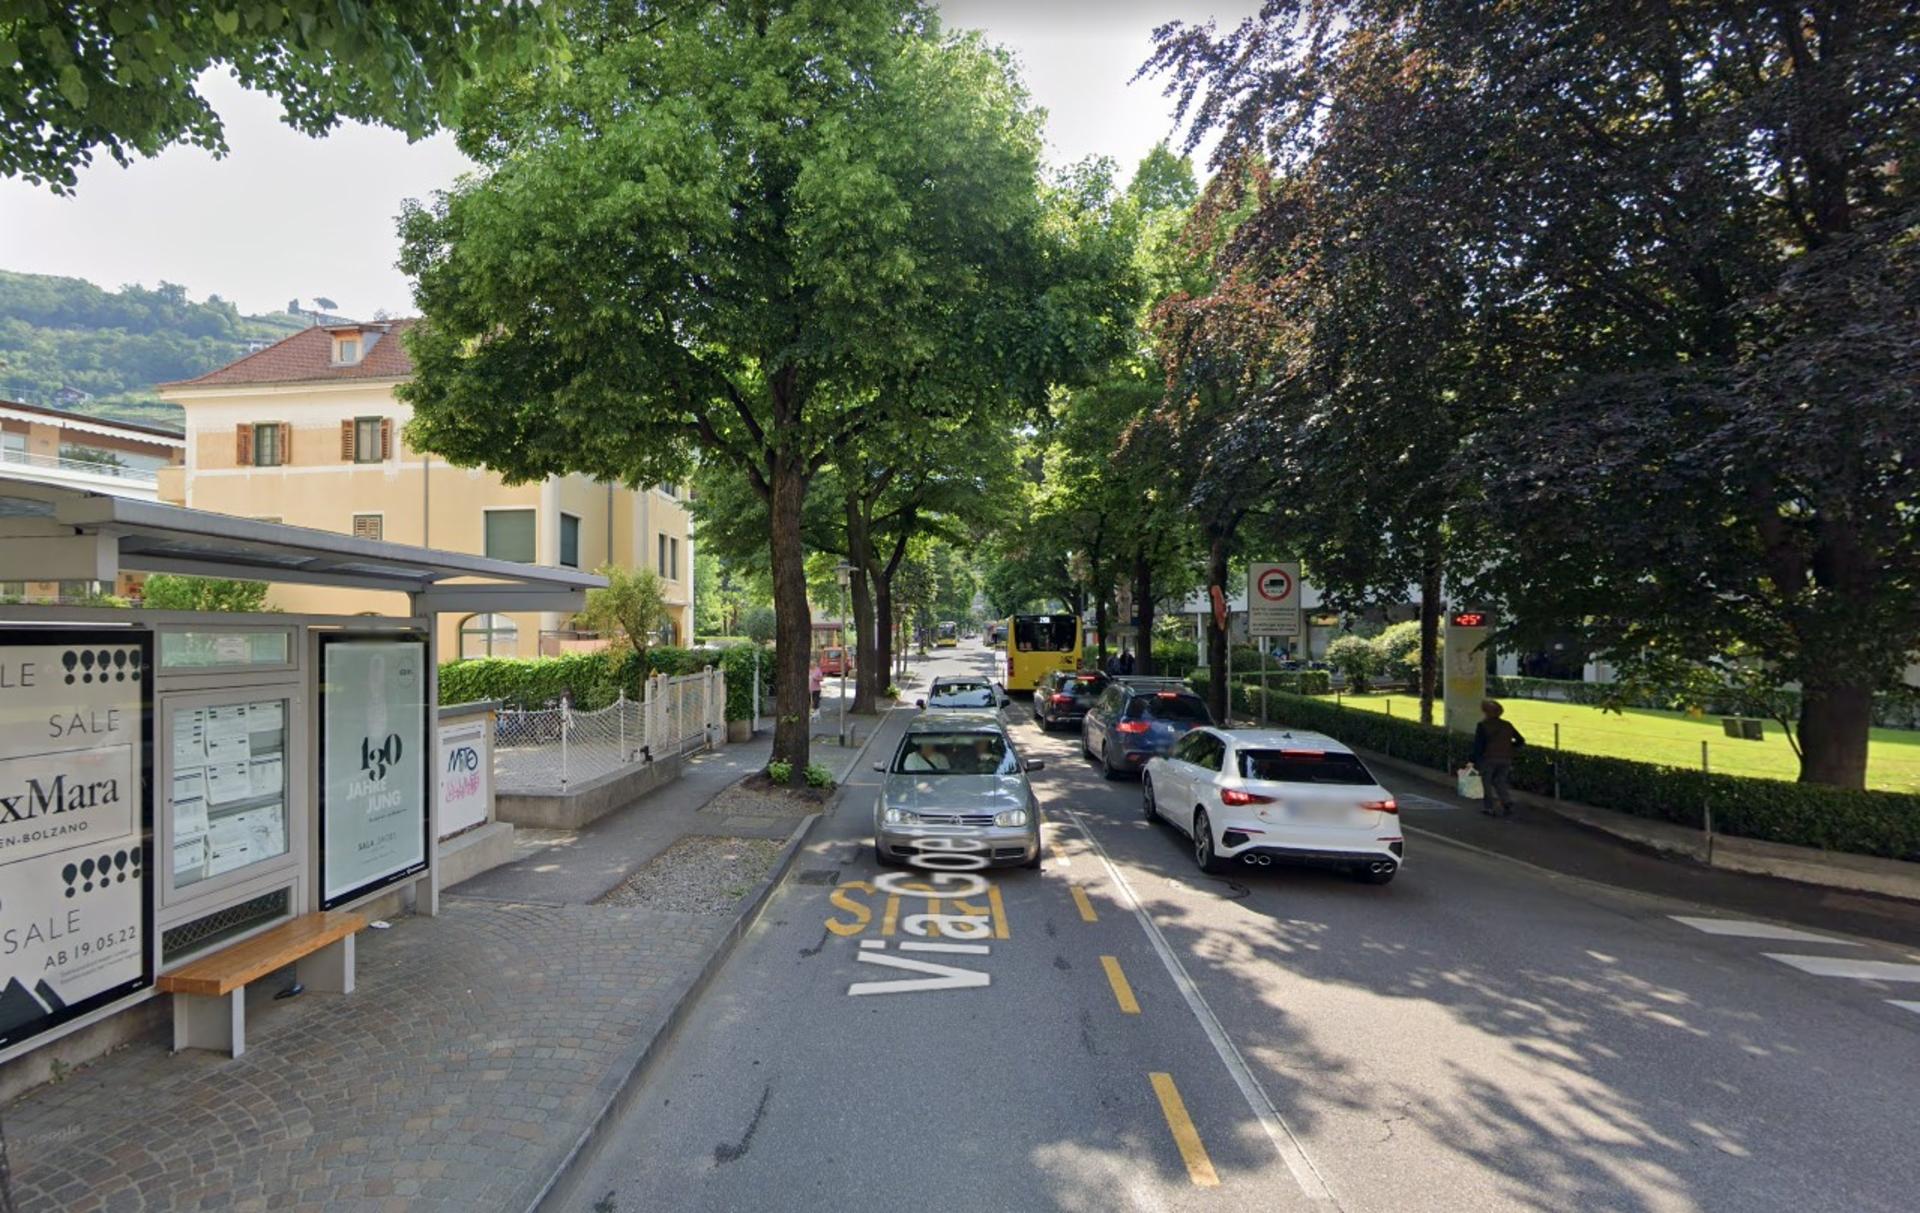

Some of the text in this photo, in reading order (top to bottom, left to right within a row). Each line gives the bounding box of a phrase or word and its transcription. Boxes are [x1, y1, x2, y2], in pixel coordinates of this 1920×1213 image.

[49, 709, 120, 738] SALE
[360, 733, 402, 781] 130
[0, 774, 120, 824] xMara
[366, 789, 402, 814] JUNG
[3, 909, 80, 954] SALE
[44, 951, 68, 971] AB
[74, 925, 137, 960] 19.05.22
